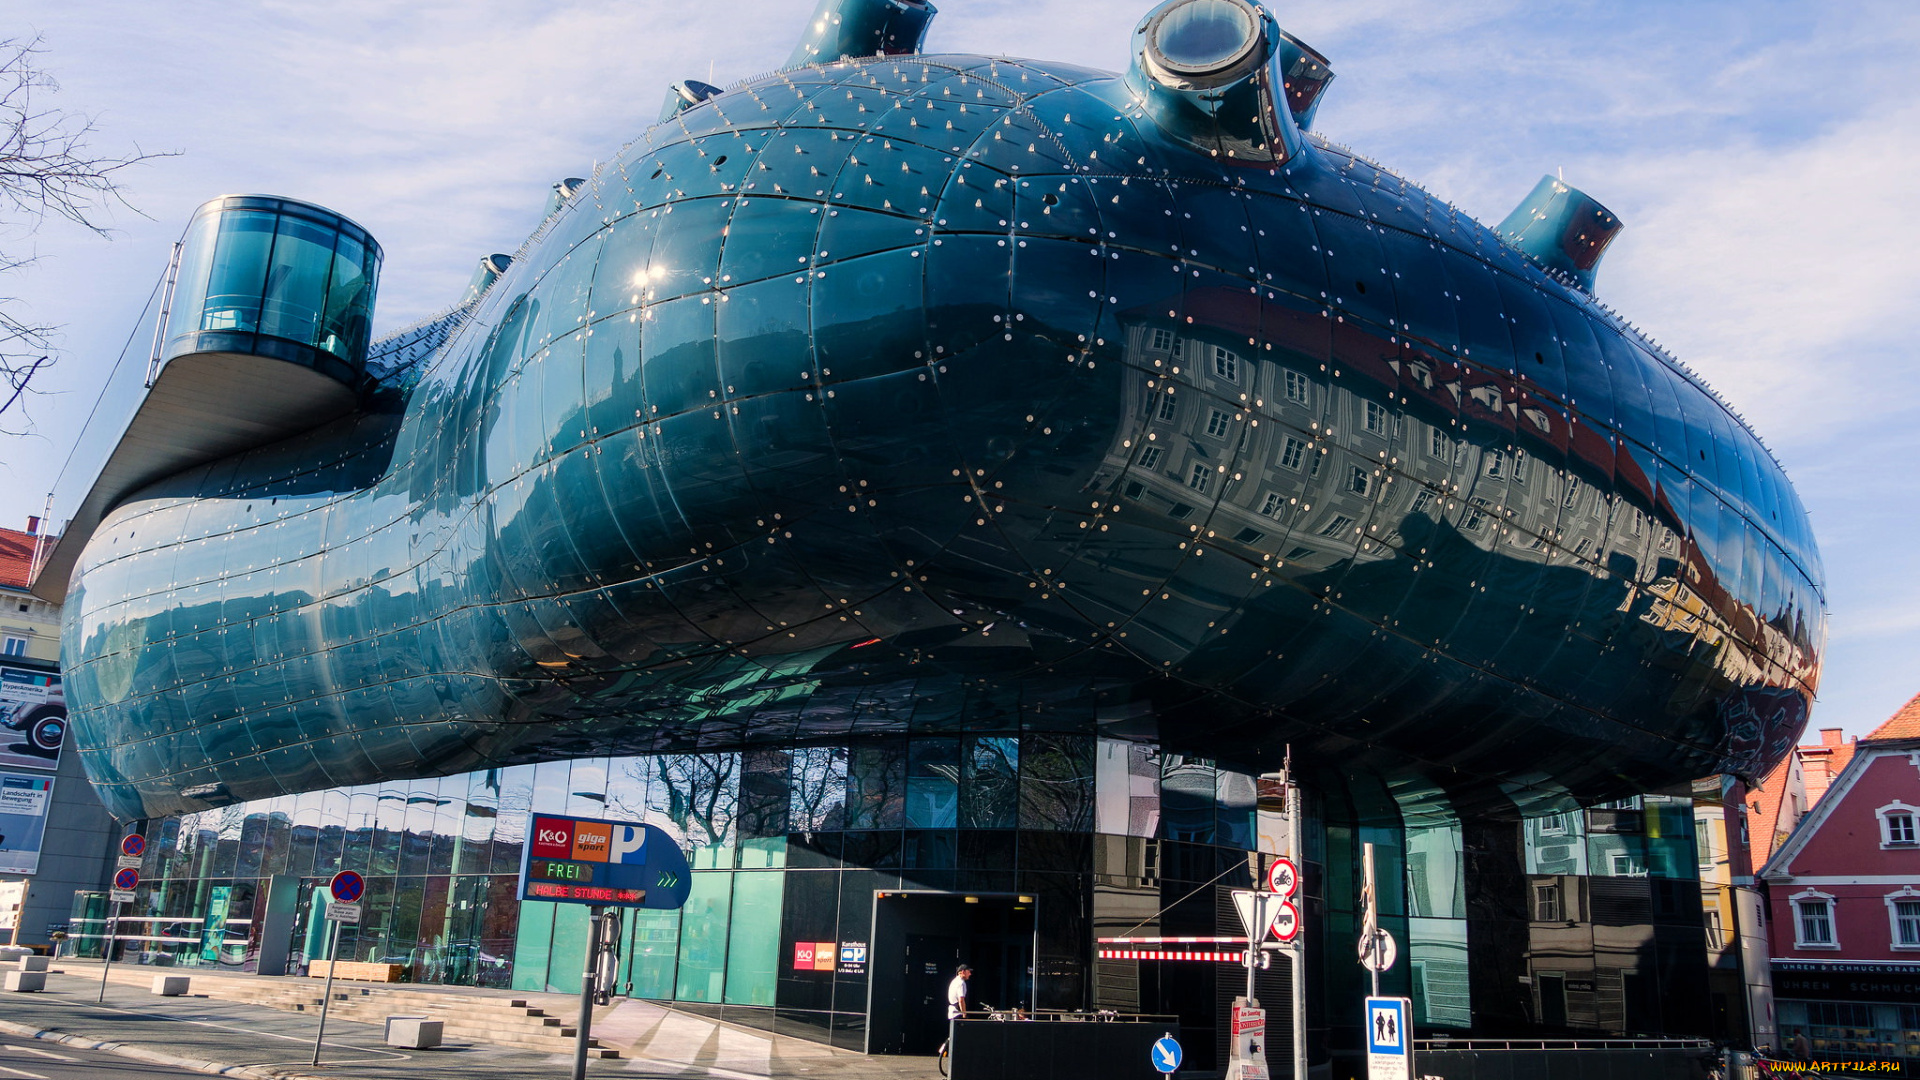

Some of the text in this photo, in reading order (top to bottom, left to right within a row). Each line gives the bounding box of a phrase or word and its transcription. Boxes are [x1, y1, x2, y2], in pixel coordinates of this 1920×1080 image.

[3, 683, 44, 692] HyperAmerika
[538, 829, 568, 844] K&O
[578, 832, 606, 844] giga
[578, 844, 604, 852] sport
[610, 825, 646, 864] P
[547, 864, 580, 878] FREI
[536, 885, 568, 897] HALBE
[574, 888, 612, 900] STUNDE
[1783, 981, 1830, 990] UHREN
